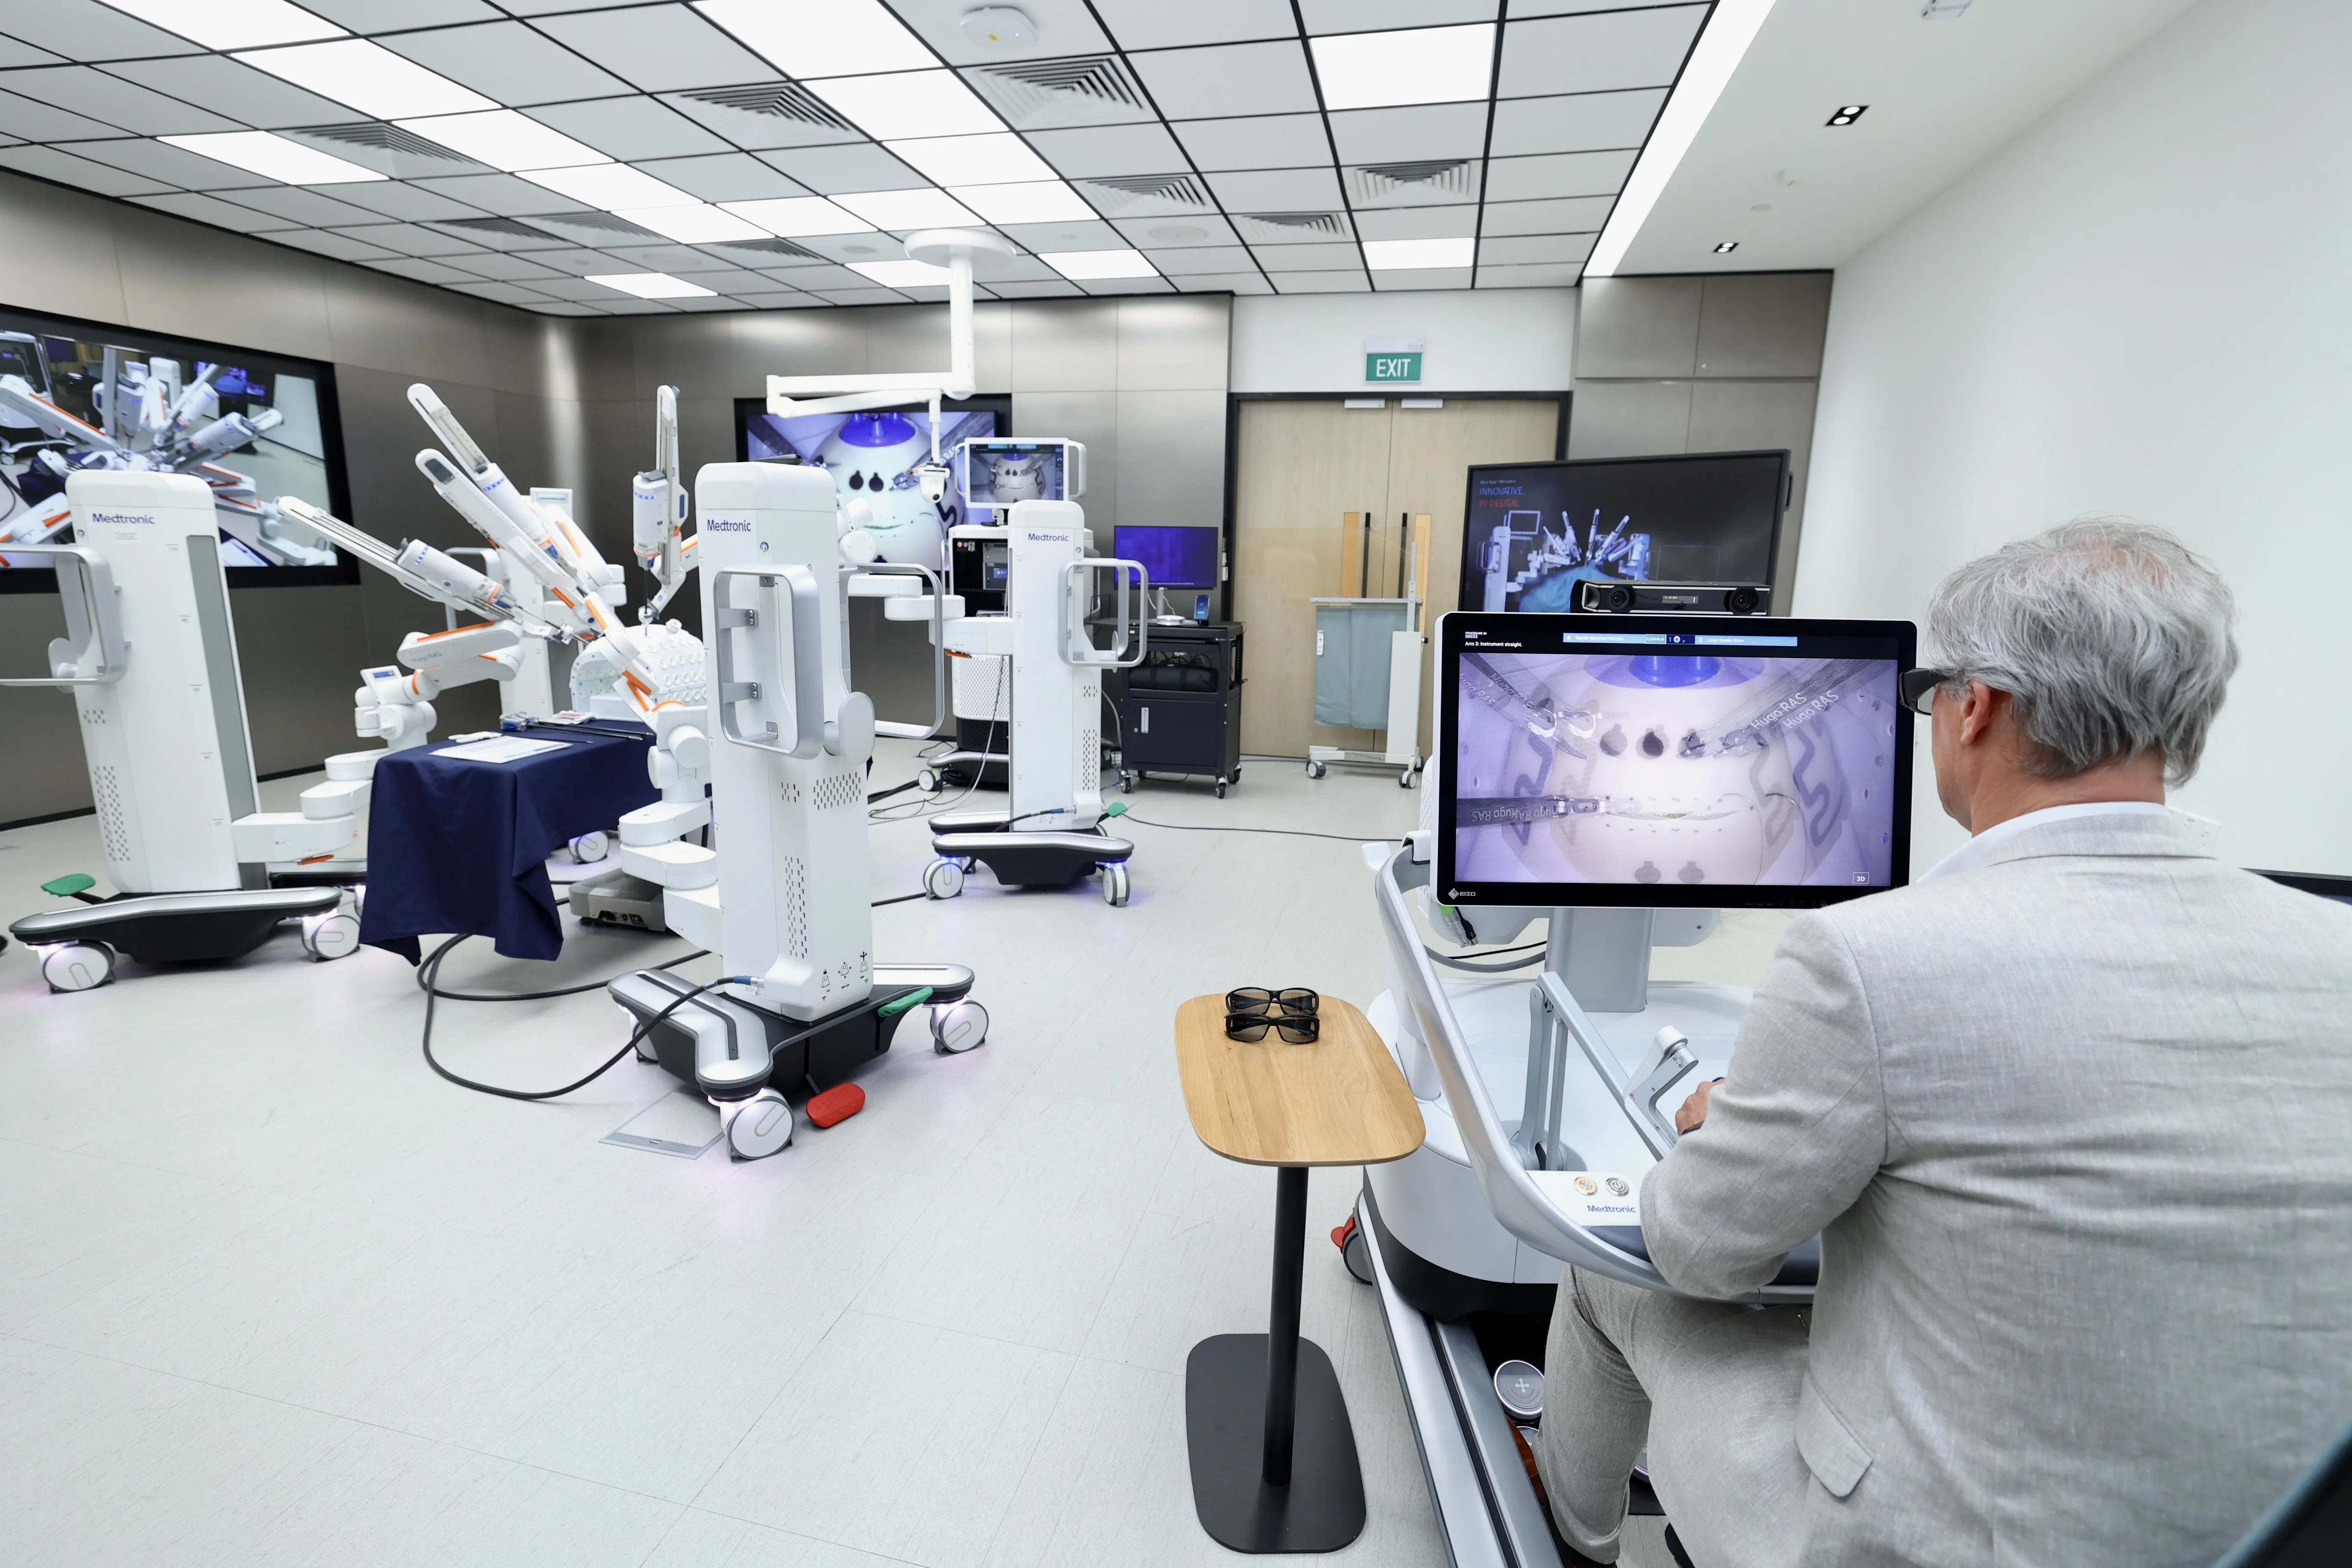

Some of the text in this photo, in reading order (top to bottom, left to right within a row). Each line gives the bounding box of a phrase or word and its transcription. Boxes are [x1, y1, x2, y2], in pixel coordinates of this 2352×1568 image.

[1376, 358, 1411, 377] EXIT
[1480, 486, 1525, 495] INNOVATIVE.
[1489, 499, 1520, 507] DESIGN.
[92, 513, 155, 524] Medtronic
[707, 519, 751, 532] Medtronic
[1028, 533, 1069, 542] Medtronic
[1489, 673, 1514, 695] Hugo
[1476, 690, 1495, 705] RAS
[1750, 692, 1807, 729] Hugo RAS
[1782, 690, 1839, 729] Hugo RAS
[1472, 810, 1491, 822] RAS
